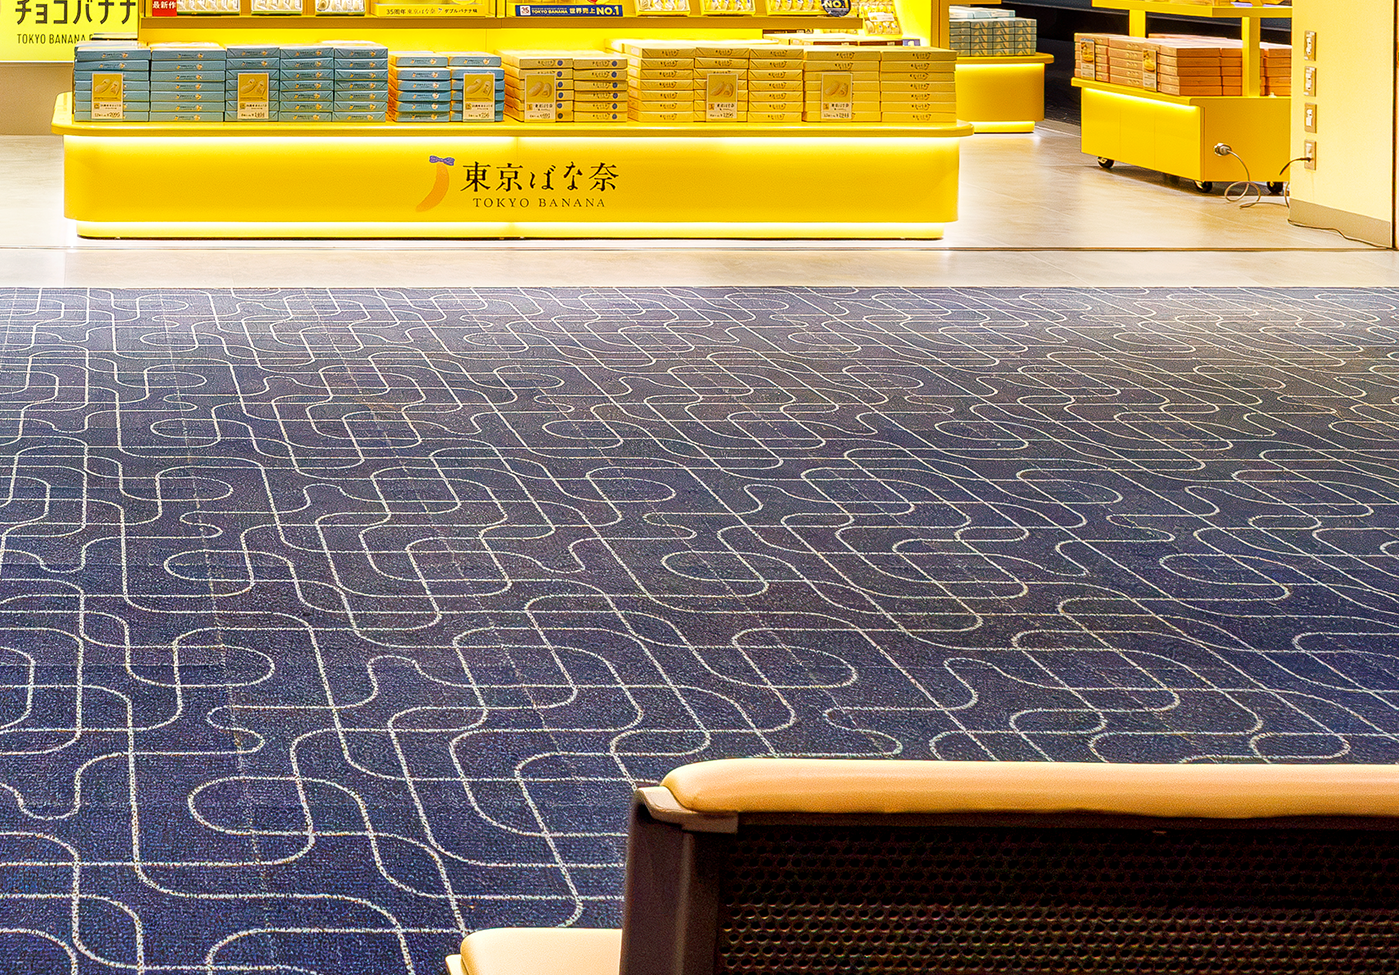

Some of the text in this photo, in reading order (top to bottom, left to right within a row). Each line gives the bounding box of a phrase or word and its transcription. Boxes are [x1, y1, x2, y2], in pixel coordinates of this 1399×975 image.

[152, 0, 177, 9] 最新作
[596, 6, 620, 15] NO.1
[16, 33, 46, 44] TOKYO
[460, 160, 620, 193] 東京ばな奈
[472, 197, 606, 208] TOKYO BANANA
